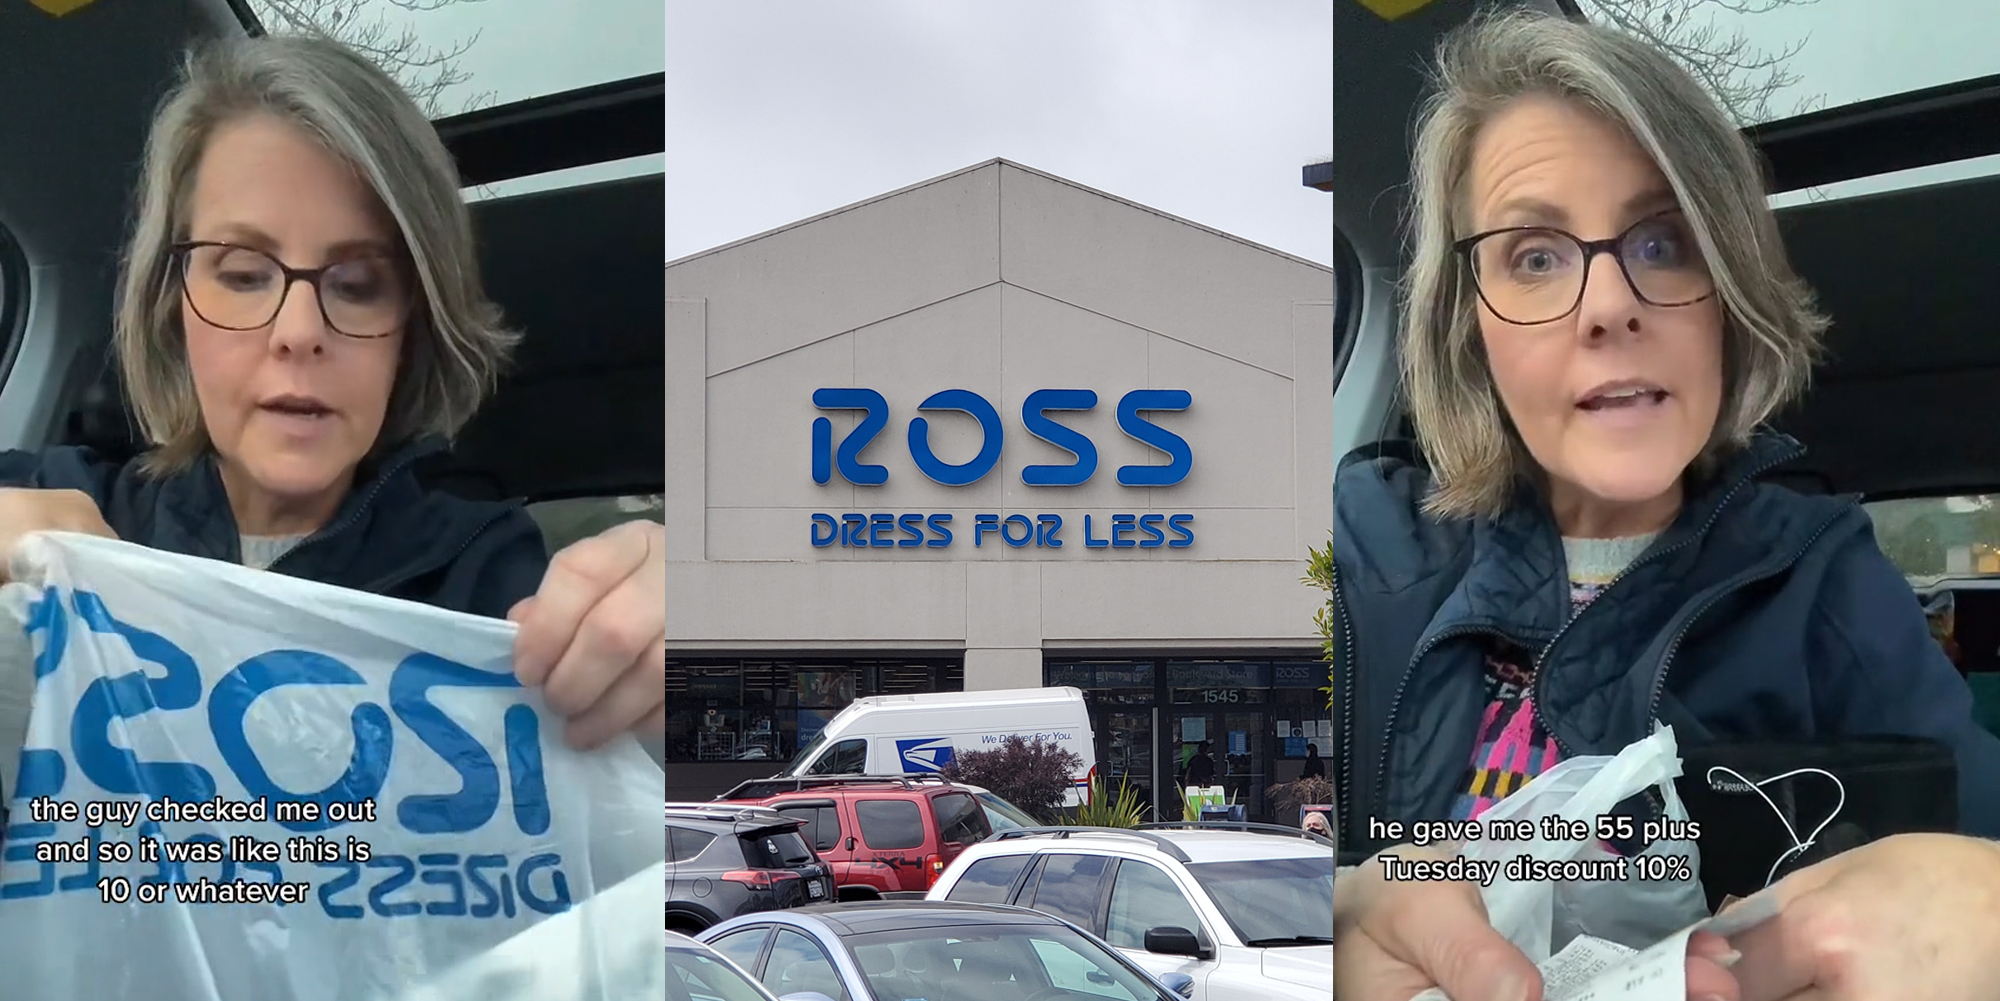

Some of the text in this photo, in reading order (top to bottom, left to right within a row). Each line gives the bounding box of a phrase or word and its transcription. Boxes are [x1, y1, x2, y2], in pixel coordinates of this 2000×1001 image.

[811, 387, 1193, 486] ROSS
[810, 513, 1195, 548] DRESS FOR LESS
[1276, 667, 1310, 679] ROSS
[1201, 689, 1239, 703] 1545
[981, 731, 1073, 744] We Deliver For You.
